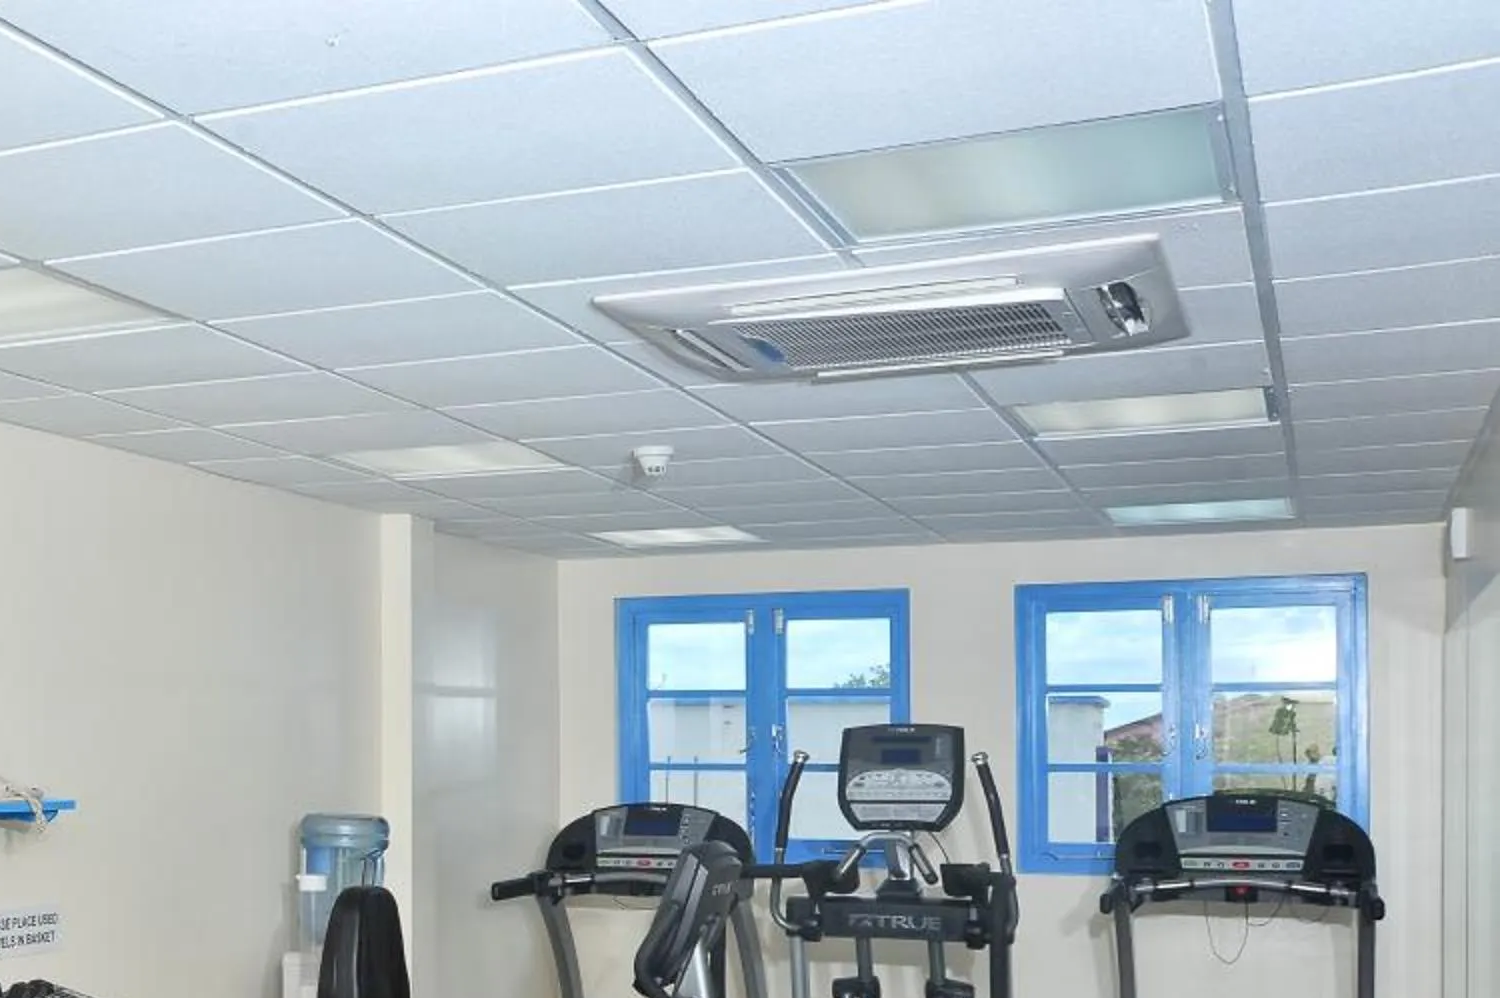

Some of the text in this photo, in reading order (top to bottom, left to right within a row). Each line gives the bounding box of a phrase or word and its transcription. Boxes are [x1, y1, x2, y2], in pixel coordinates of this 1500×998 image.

[11, 915, 37, 929] PLACE
[38, 912, 59, 927] USED
[875, 914, 941, 930] TRUE
[17, 935, 25, 946] IN
[26, 929, 55, 945] BASKET
